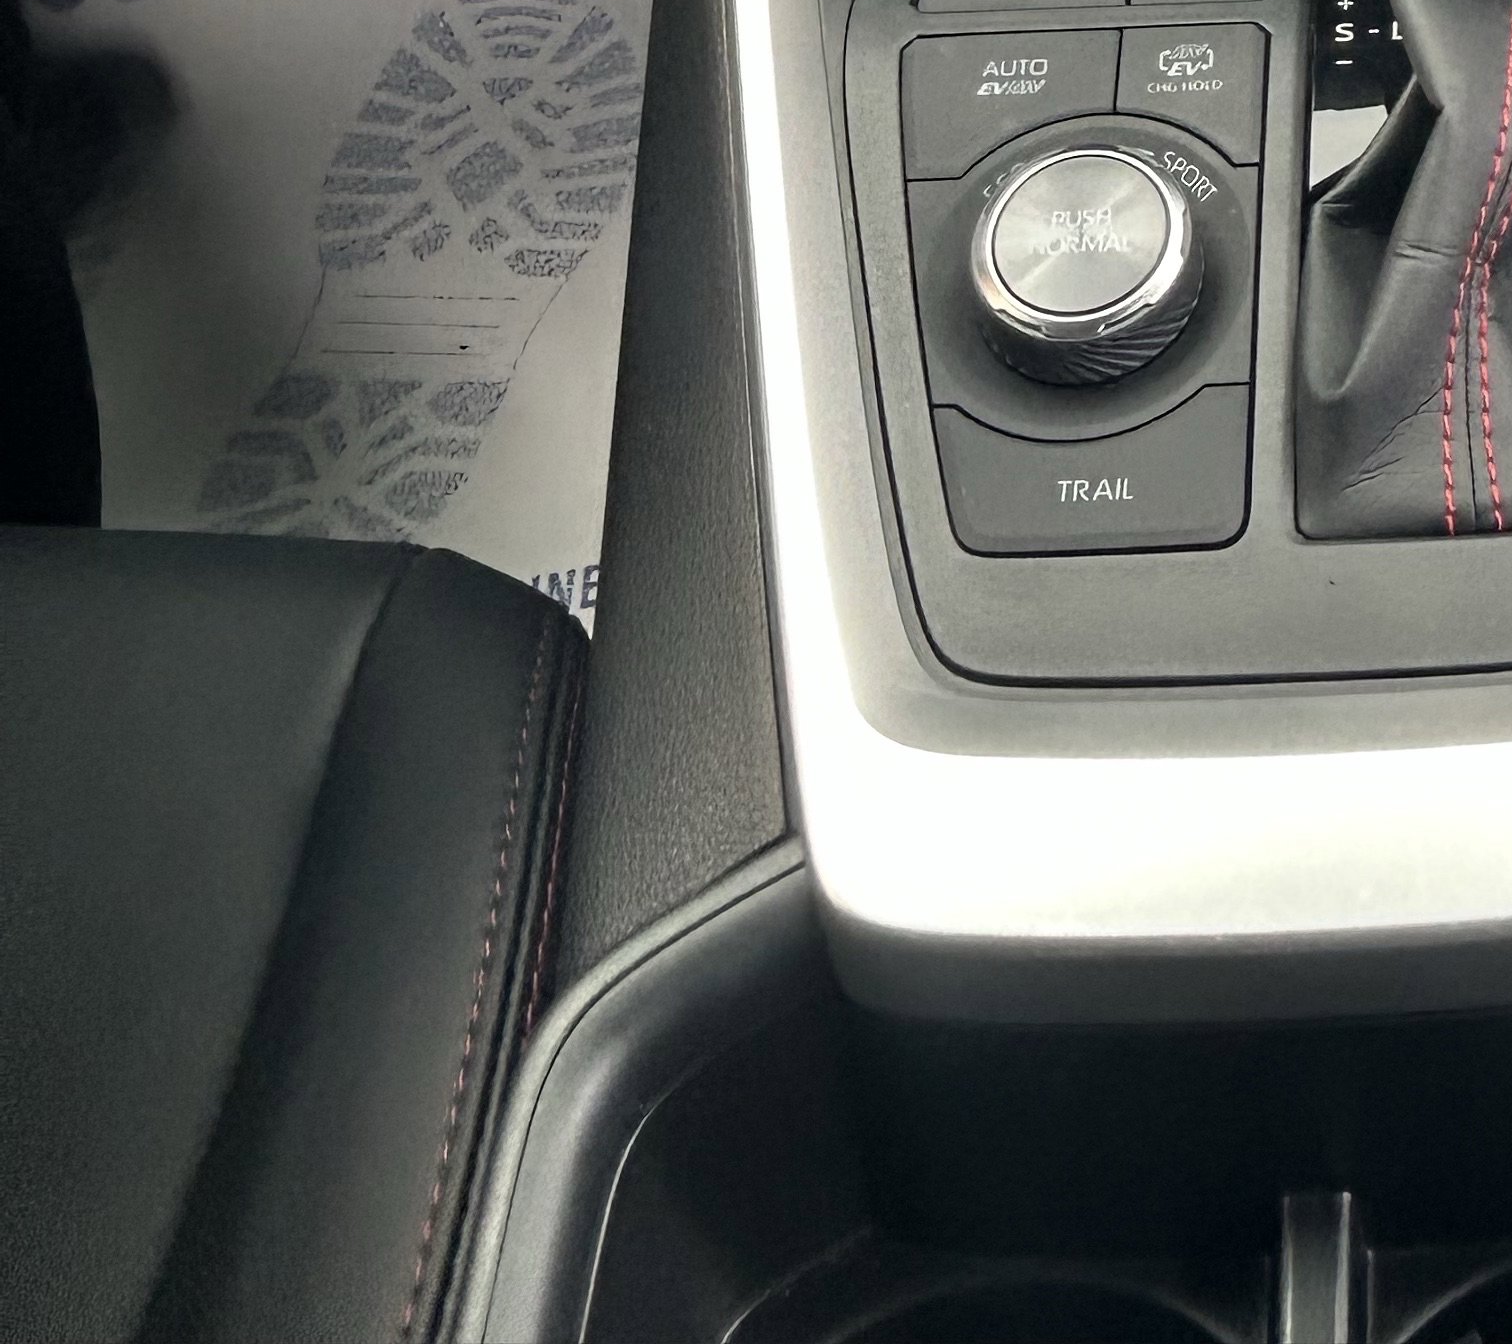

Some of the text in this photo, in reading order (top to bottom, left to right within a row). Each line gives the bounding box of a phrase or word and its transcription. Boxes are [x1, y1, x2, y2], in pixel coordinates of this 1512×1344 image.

[981, 58, 1049, 78] AUTO
[1162, 150, 1218, 202] SPORT
[1051, 206, 1113, 230] PUSH
[1029, 232, 1133, 256] NORMAL
[1057, 477, 1134, 503] TRAIL
